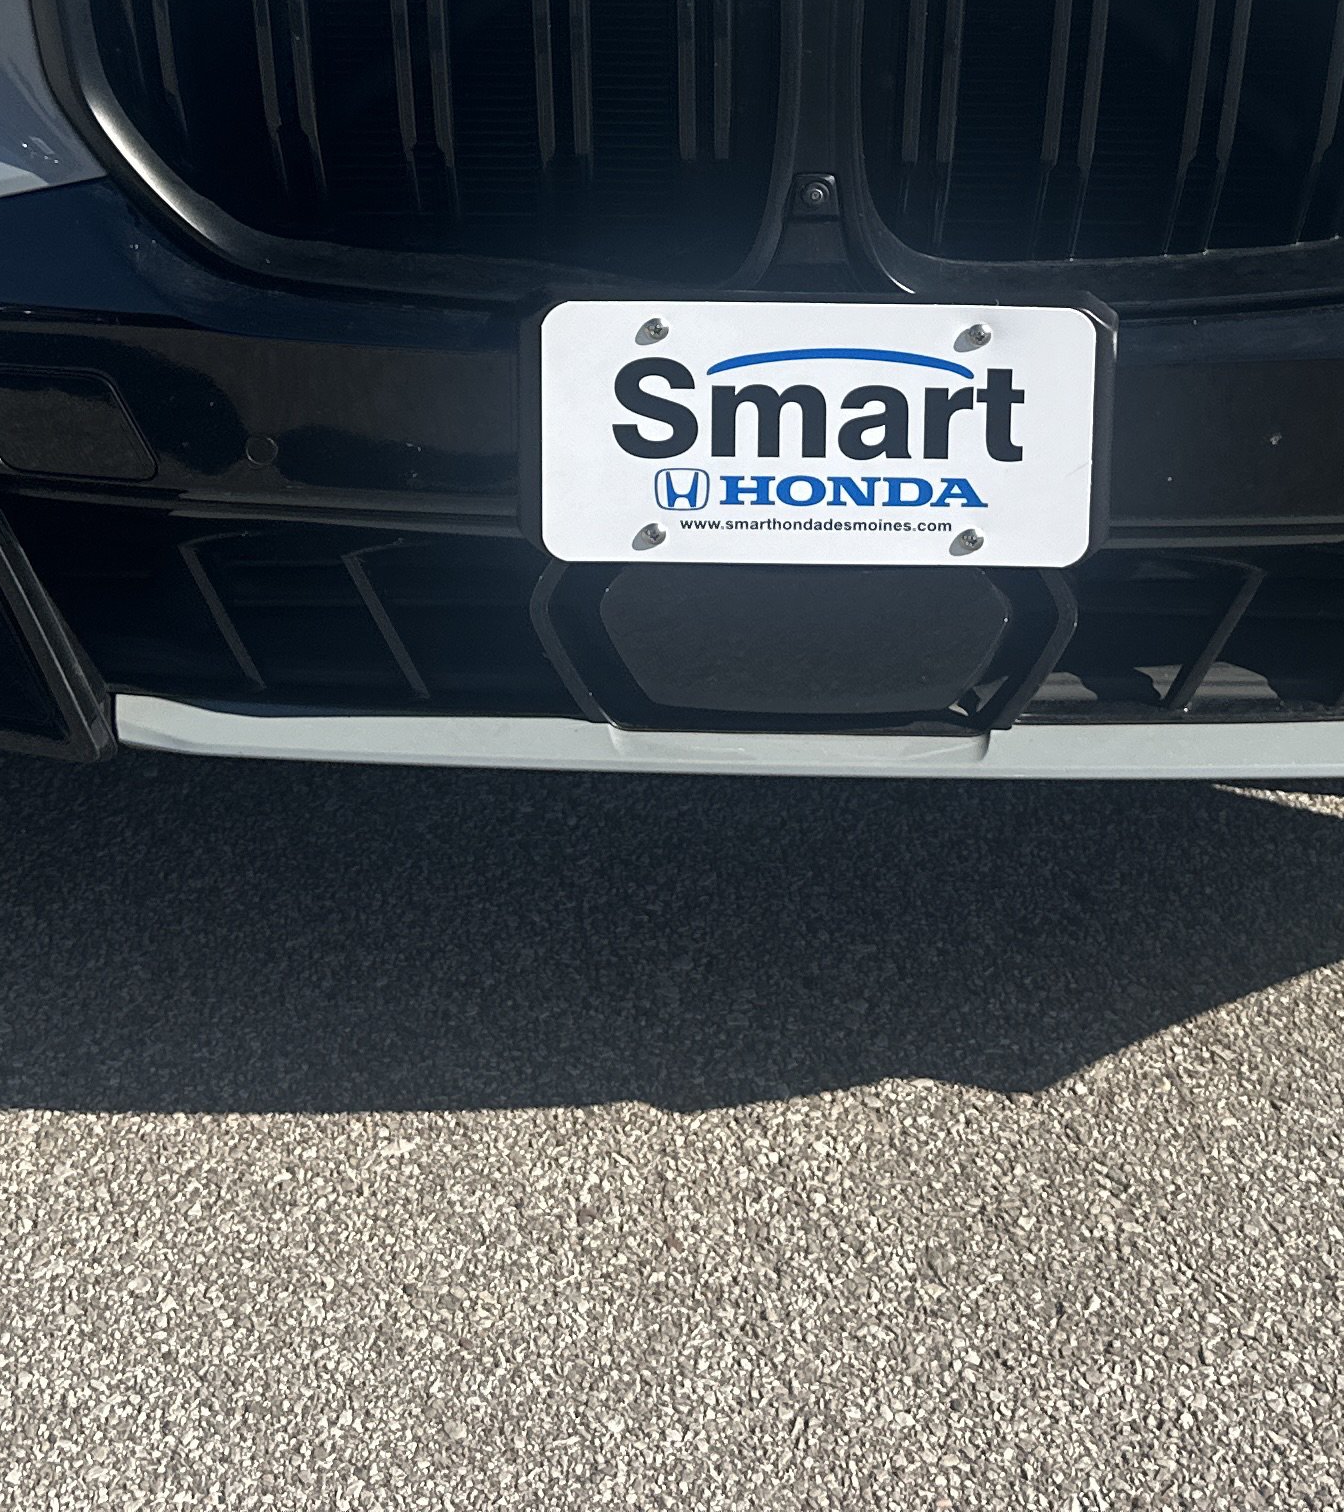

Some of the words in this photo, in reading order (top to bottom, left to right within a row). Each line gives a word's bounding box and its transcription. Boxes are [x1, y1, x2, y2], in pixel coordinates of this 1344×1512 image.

[611, 356, 1025, 463] Smart
[719, 474, 989, 508] HONDA
[679, 517, 952, 532] www.smarthondadesmoines.com
